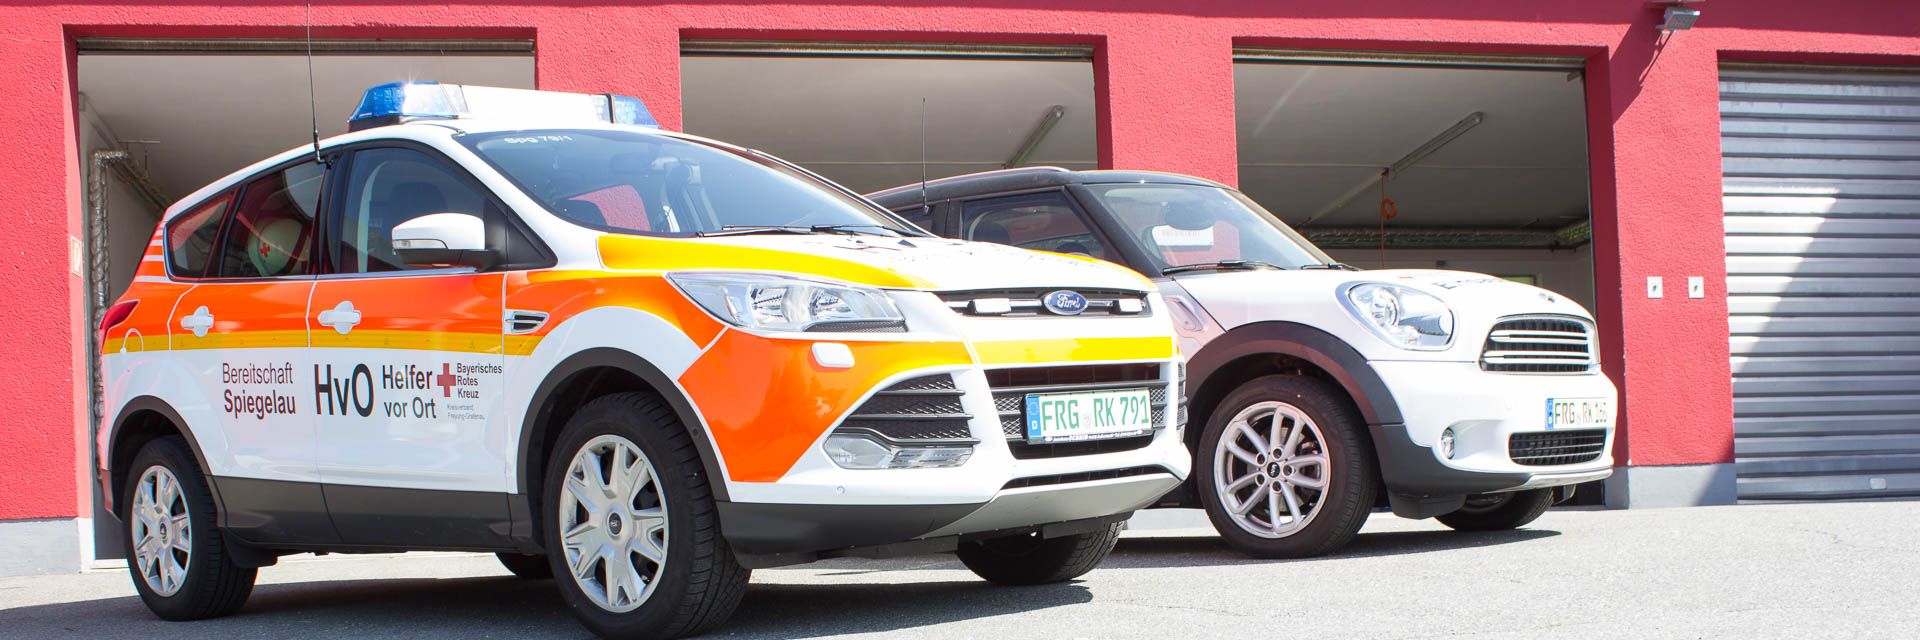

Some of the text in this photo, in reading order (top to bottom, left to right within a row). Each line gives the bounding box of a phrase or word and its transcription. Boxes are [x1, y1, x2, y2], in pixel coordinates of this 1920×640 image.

[1057, 293, 1080, 308] Ford
[222, 362, 293, 384] Bereitschaft
[382, 364, 433, 390] Helfer
[456, 363, 503, 376] Bayerisches
[457, 375, 479, 386] Rotes
[314, 363, 374, 417] HvO
[457, 387, 480, 399] Kreuz
[224, 389, 296, 420] Spiegelau
[384, 396, 437, 419] vor Ort
[1041, 395, 1149, 431] FRG RK 791
[1554, 402, 1575, 424] FRG
